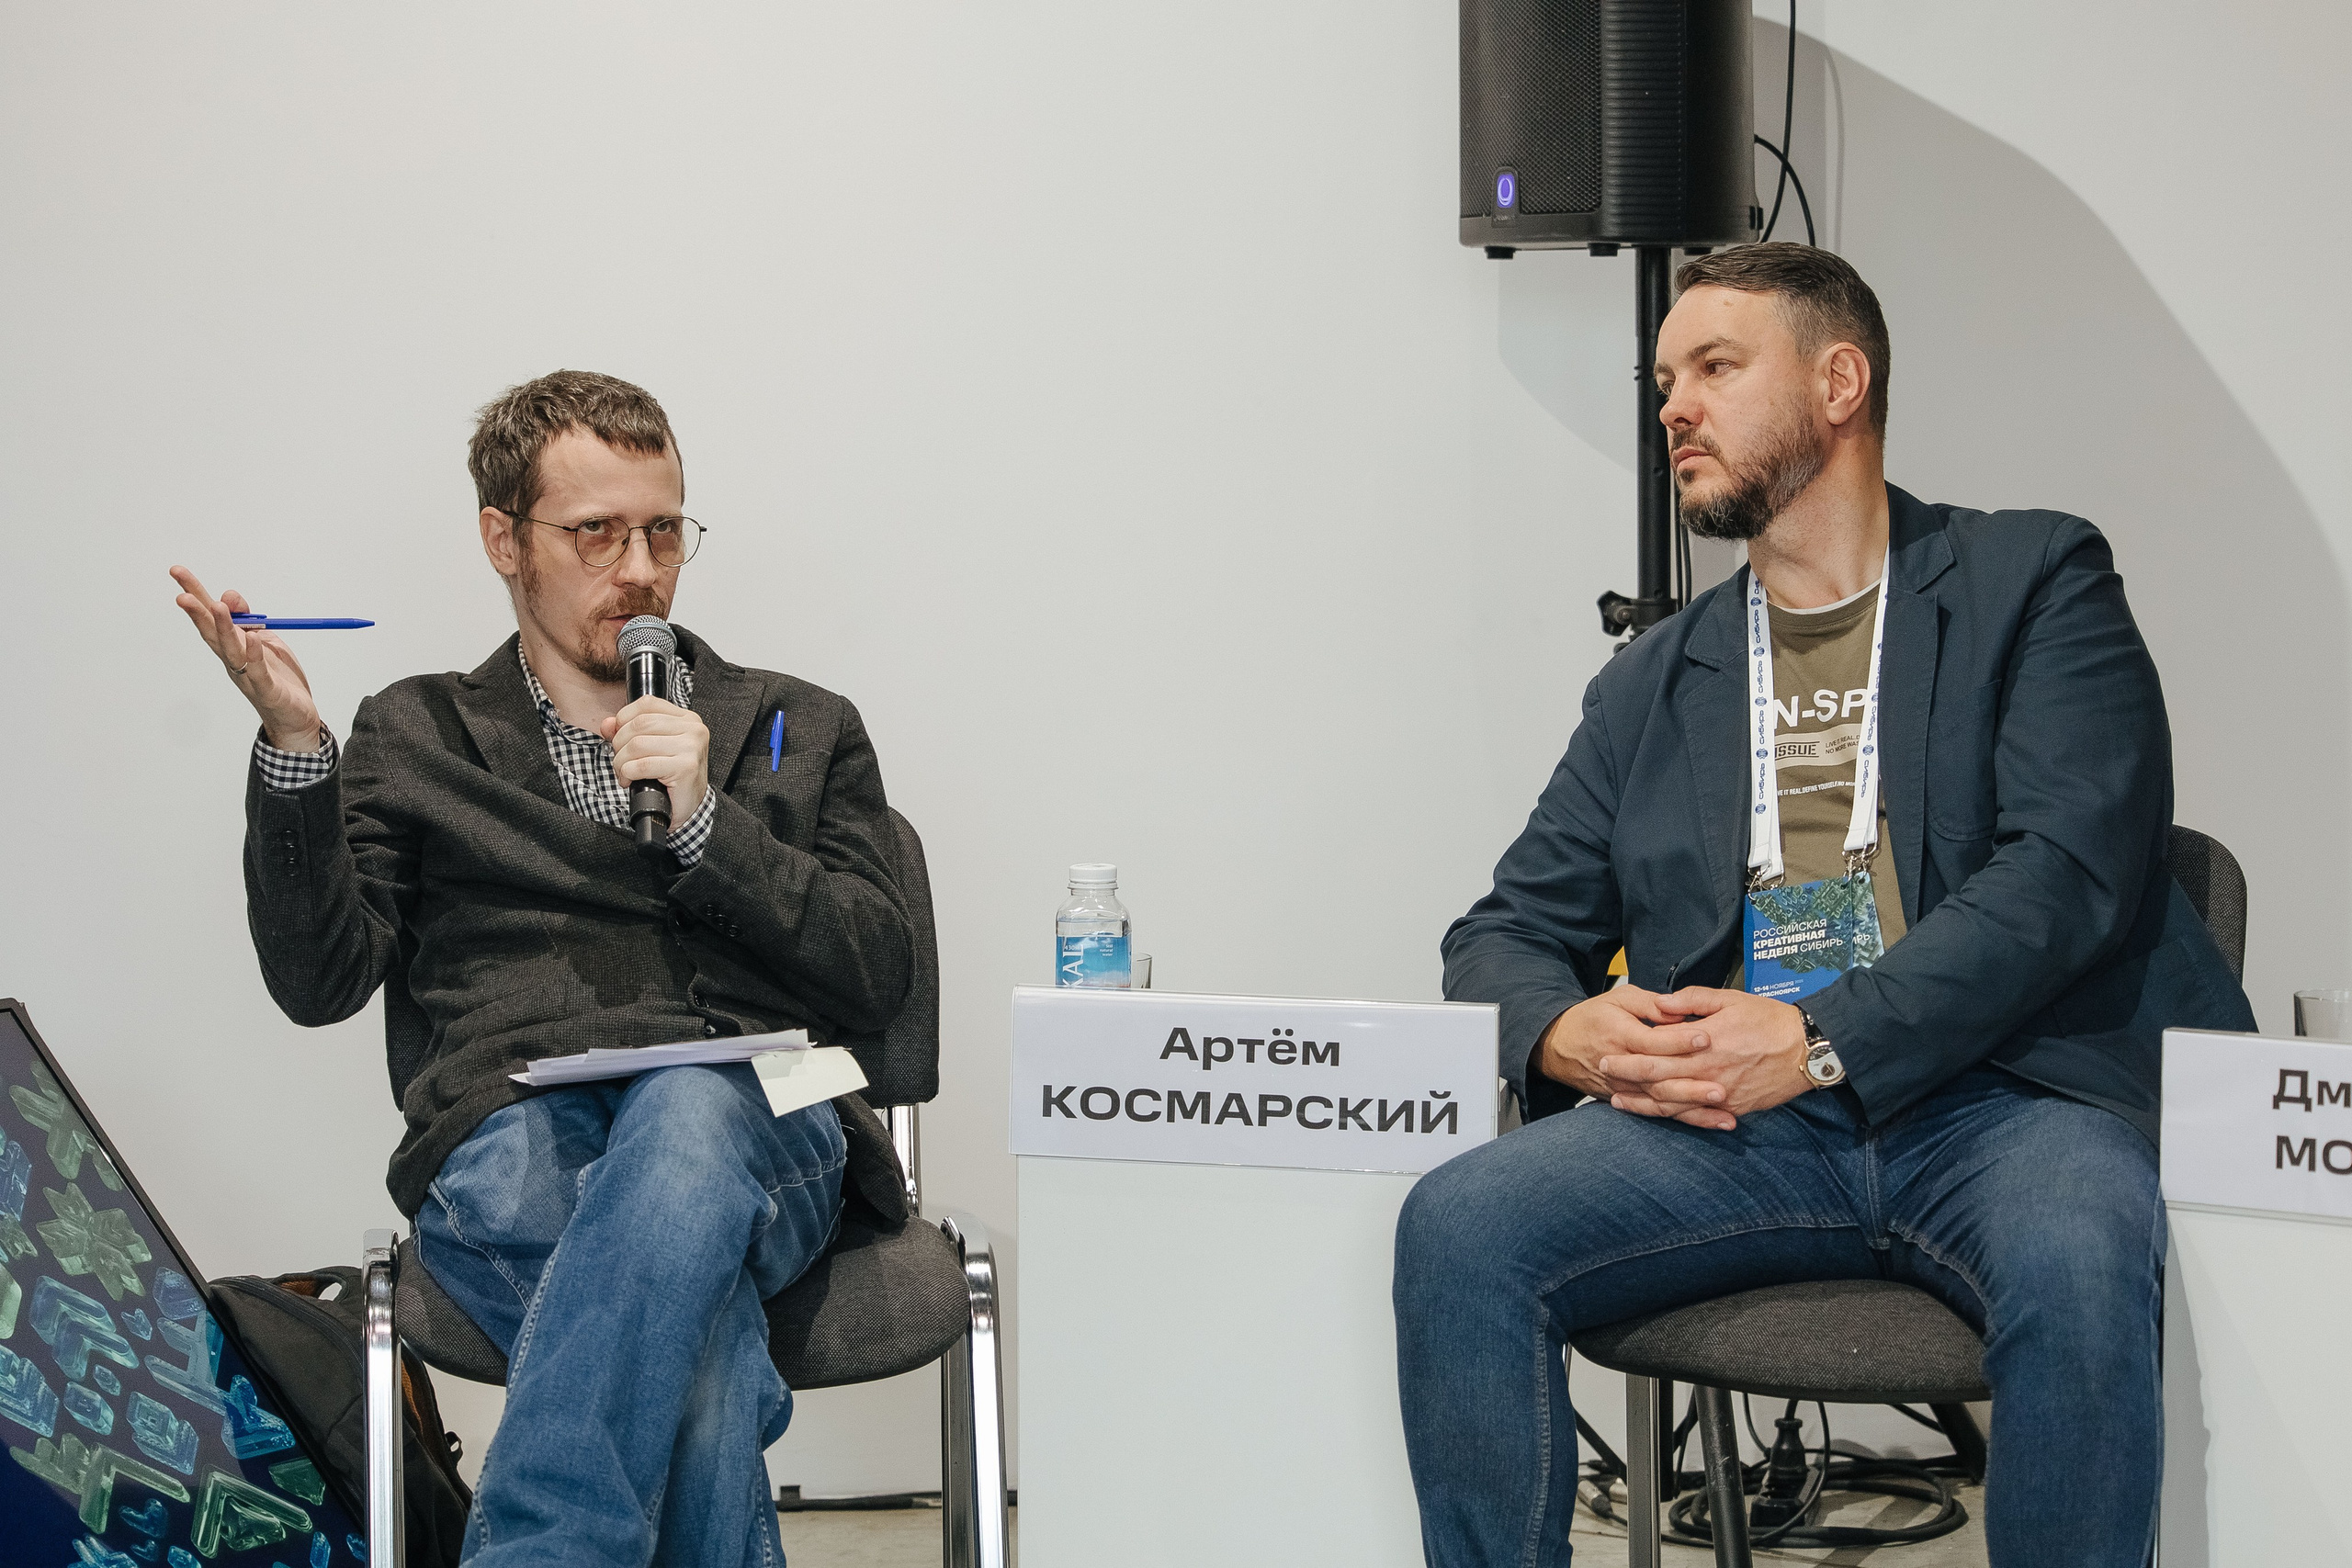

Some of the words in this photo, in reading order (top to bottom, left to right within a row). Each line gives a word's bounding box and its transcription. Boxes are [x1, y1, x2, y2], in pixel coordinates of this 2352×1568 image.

[1774, 744, 1817, 758] ISSUE
[1835, 743, 1847, 751] MORE
[1753, 919, 1827, 939] РОССИЙСКАЯ
[1753, 929, 1826, 950] КРЕАТИВНАЯ
[1753, 944, 1798, 960] НЕДЕЛЯ
[1800, 937, 1843, 953] СИБИРЬ
[1770, 980, 1794, 989] НОЯБРЯ
[1159, 1027, 1340, 1071] Артём
[2272, 1068, 2352, 1112] Дм
[1041, 1084, 1459, 1135] КОСМАРСКИЙ
[2276, 1134, 2352, 1175] МО
